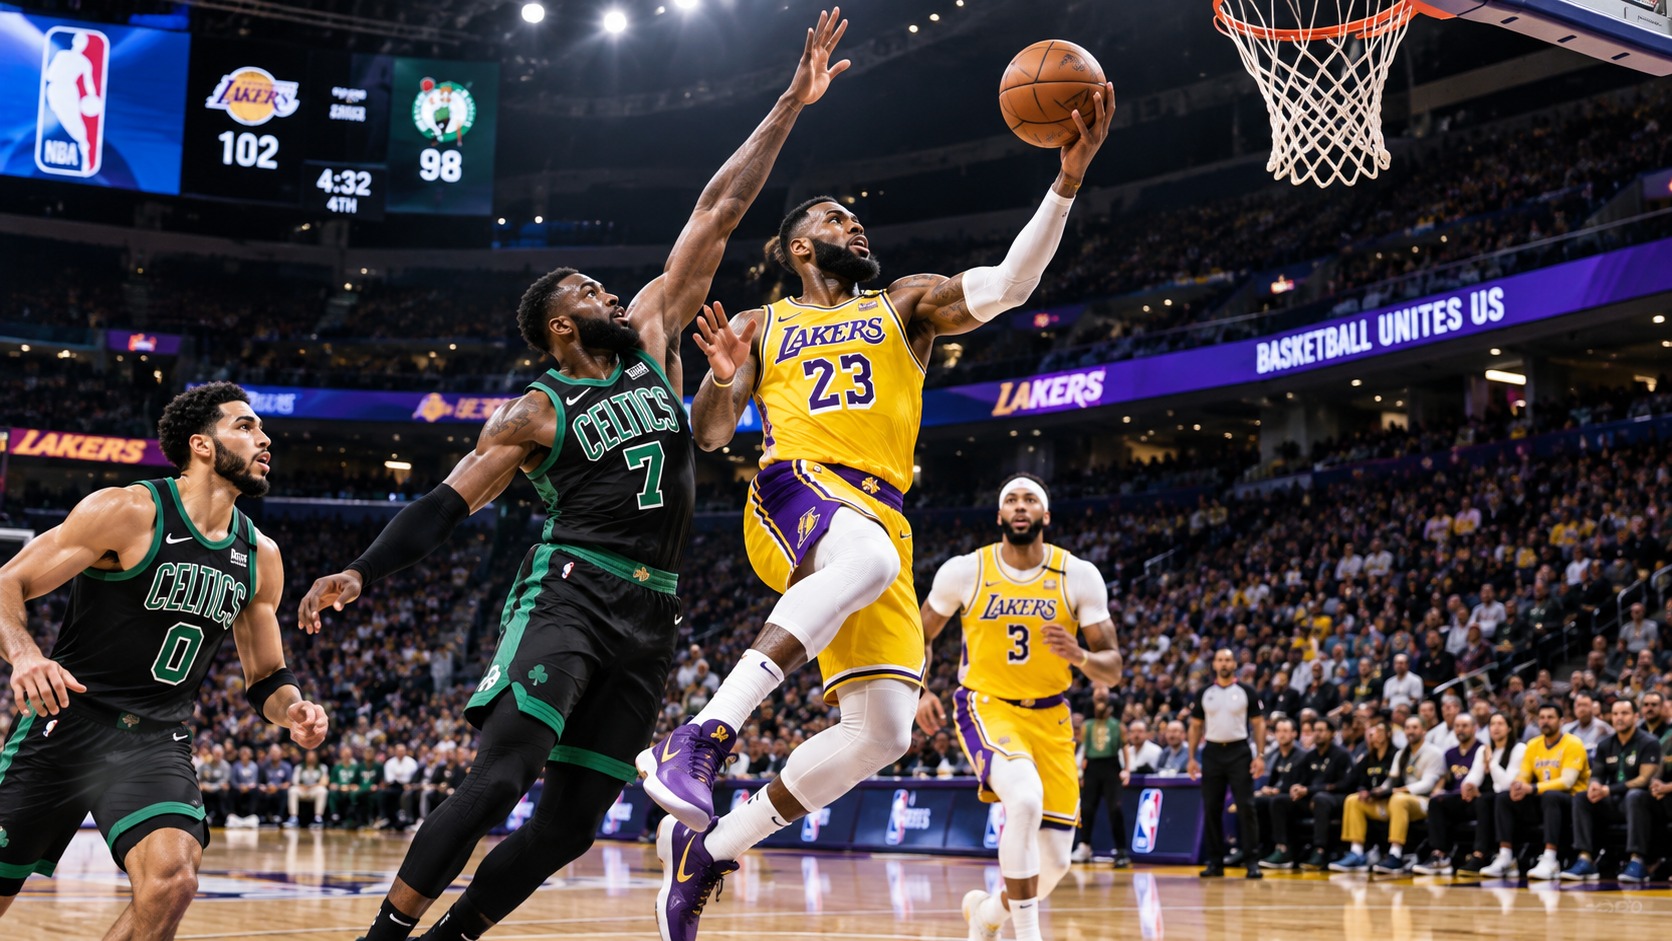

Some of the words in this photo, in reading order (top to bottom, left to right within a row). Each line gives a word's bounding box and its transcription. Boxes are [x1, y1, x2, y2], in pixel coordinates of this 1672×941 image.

[209, 78, 299, 115] LAKERS
[44, 139, 79, 166] NBA
[218, 130, 279, 169] 102
[419, 148, 462, 182] 98
[316, 168, 372, 196] 4:32
[326, 196, 358, 213] 4TH
[774, 317, 887, 365] LAKERS
[1256, 318, 1373, 375] BASKETBALL
[1378, 296, 1463, 347] UNITES
[1470, 286, 1505, 326] US
[802, 352, 876, 416] 23
[991, 369, 1106, 417] LAKERS
[572, 385, 680, 462] CELTICS
[13, 429, 147, 464] LAKERS
[623, 440, 666, 510] 7
[144, 562, 247, 631] CELTICS
[979, 593, 1057, 621] LAKERS
[150, 621, 204, 686] 0
[1007, 623, 1030, 665] 3
